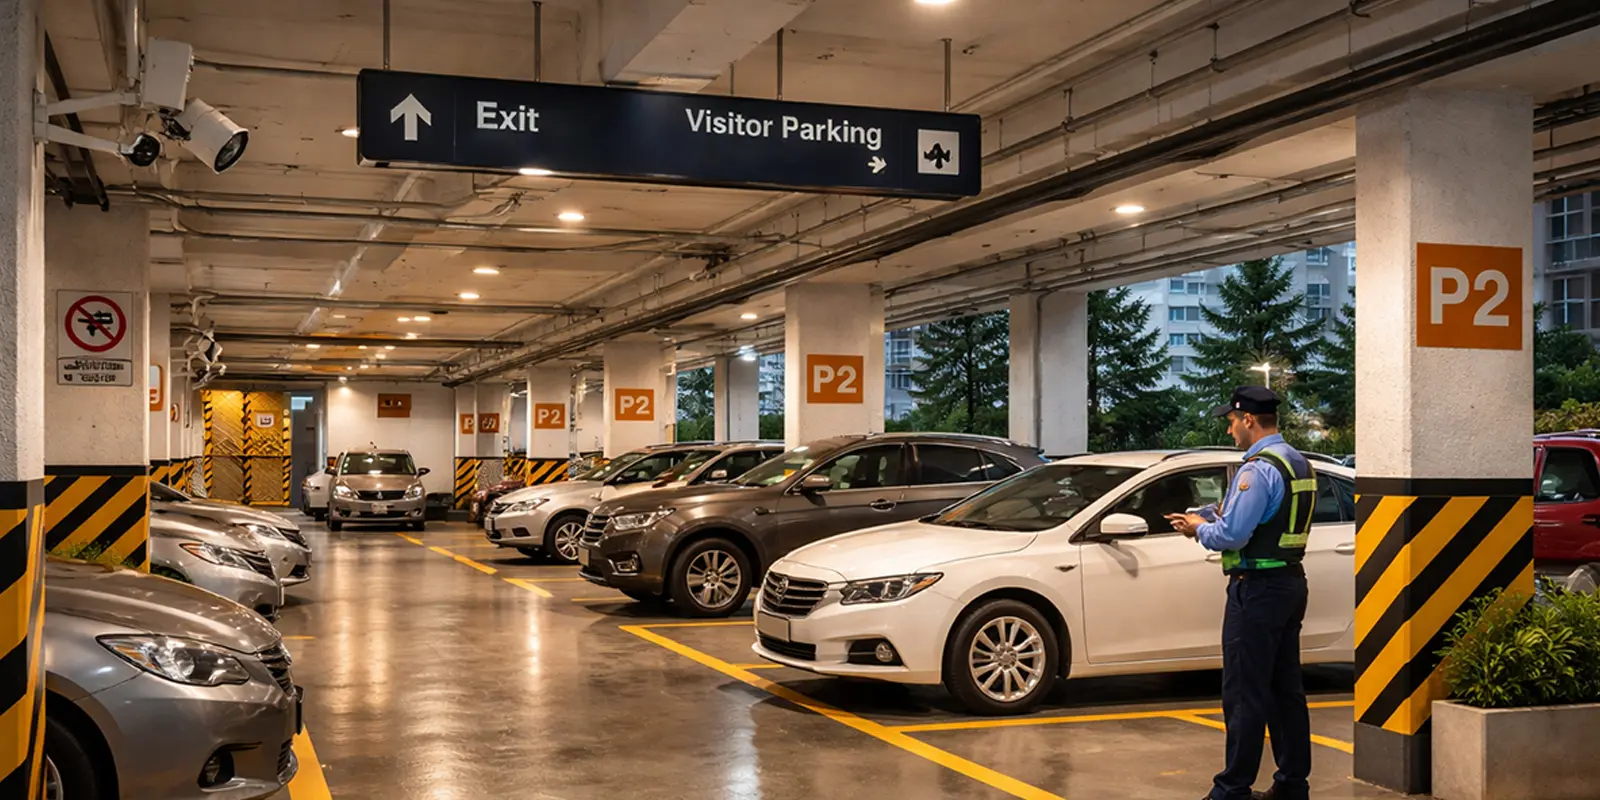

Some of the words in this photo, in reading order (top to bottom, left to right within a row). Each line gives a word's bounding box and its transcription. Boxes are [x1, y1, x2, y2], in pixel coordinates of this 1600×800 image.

[476, 101, 539, 133] Exit
[685, 108, 774, 138] Visitor
[781, 115, 882, 150] Parking
[1430, 266, 1510, 327] P2
[812, 364, 858, 394] P2
[537, 408, 561, 425] P2
[619, 396, 650, 415] P2
